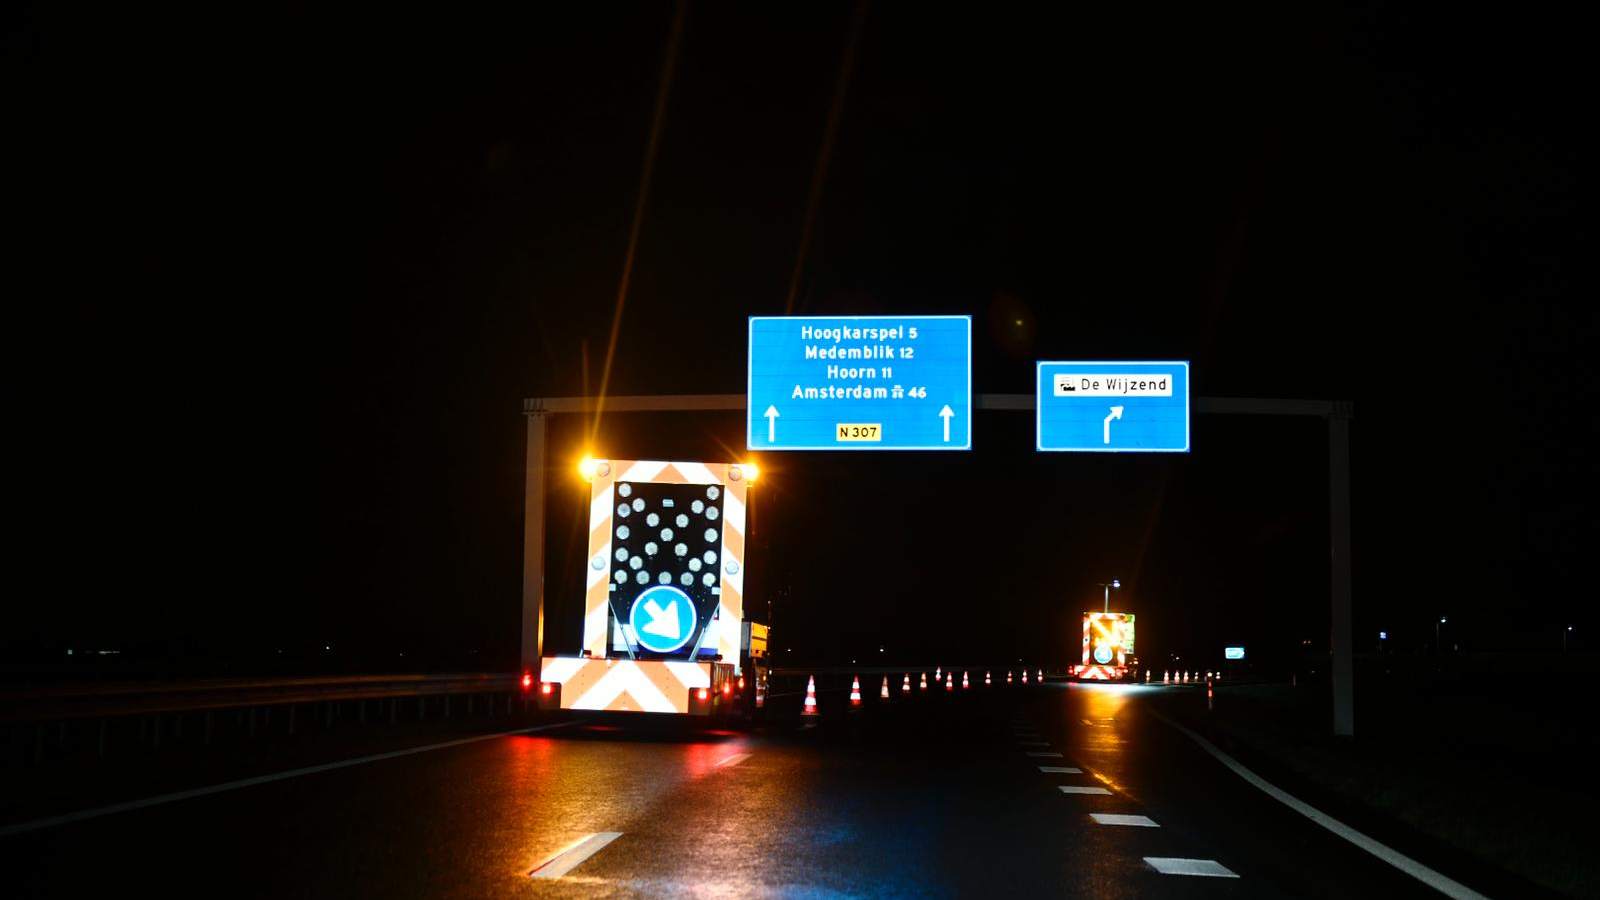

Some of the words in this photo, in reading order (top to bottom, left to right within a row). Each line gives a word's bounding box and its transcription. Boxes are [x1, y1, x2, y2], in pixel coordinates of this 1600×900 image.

[801, 325, 903, 343] Hoogkarspel
[908, 326, 918, 339] 5
[805, 345, 895, 360] Medemblik
[899, 347, 914, 359] 12
[827, 365, 876, 379] Hoorn
[881, 367, 892, 378] 11
[792, 384, 888, 399] Amsterdam
[908, 386, 927, 399] 46
[1081, 378, 1100, 391] De
[1106, 378, 1167, 394] Wijzend
[840, 427, 849, 438] N
[852, 427, 878, 438] 307
